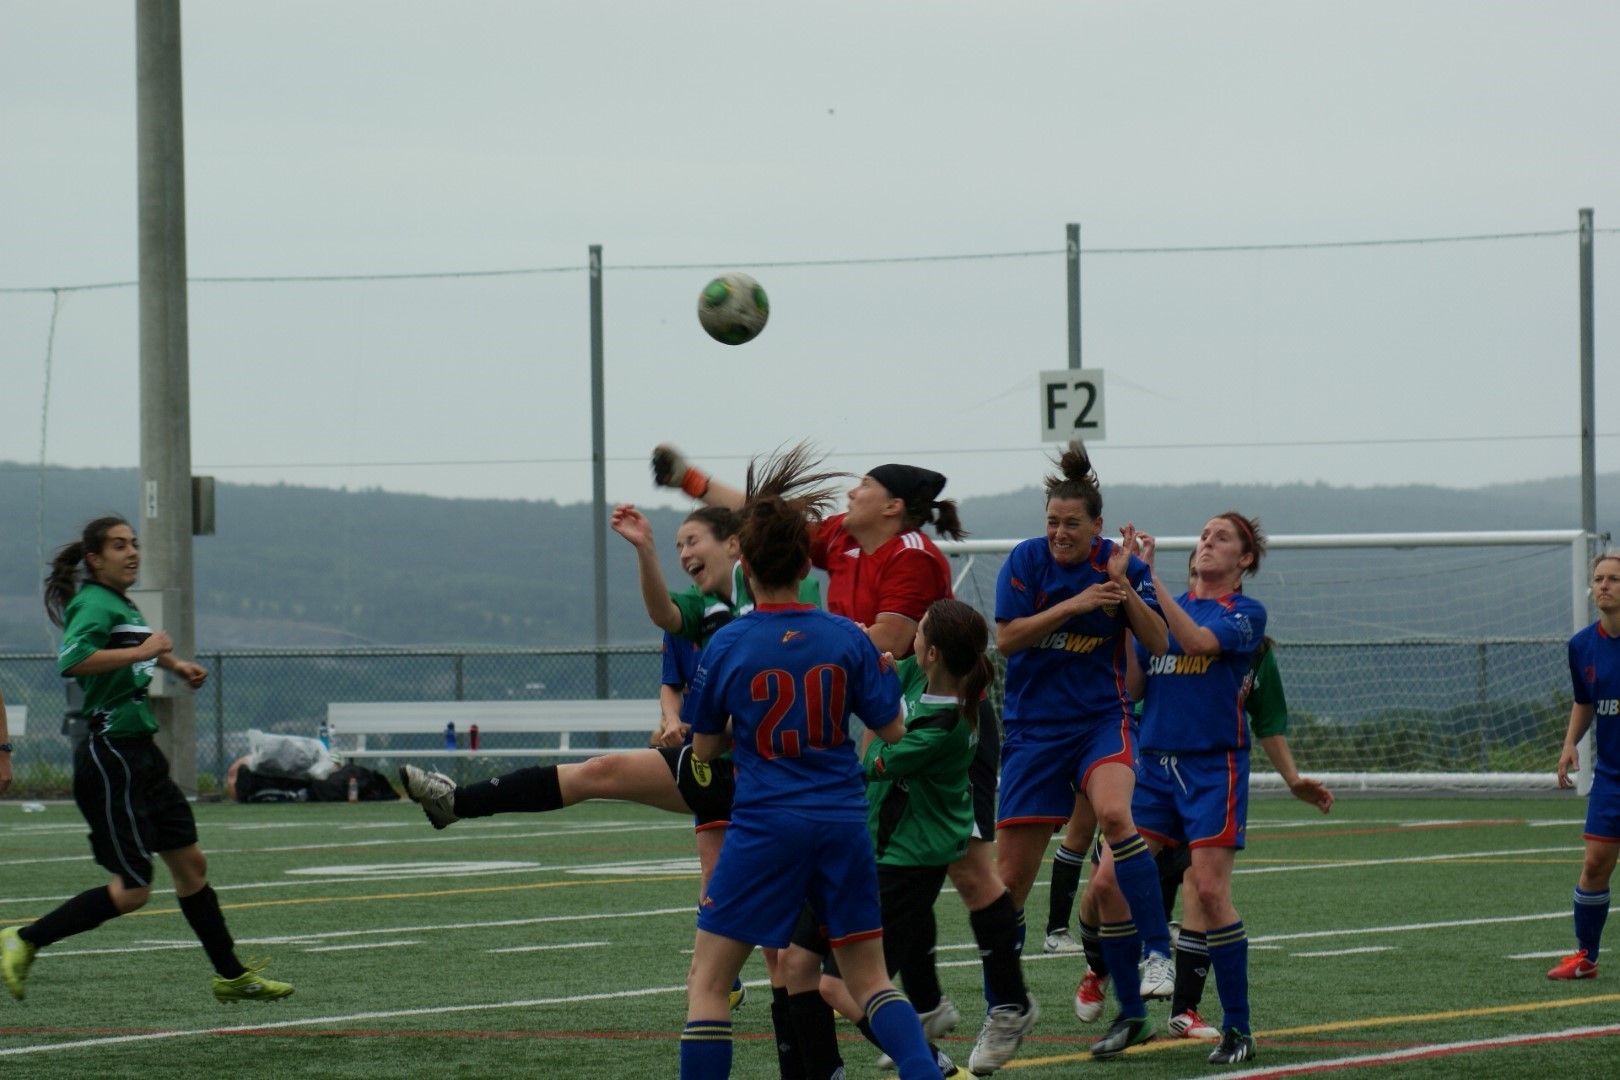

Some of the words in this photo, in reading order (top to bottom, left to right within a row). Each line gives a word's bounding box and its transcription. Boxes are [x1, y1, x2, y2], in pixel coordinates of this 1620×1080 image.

[1046, 381, 1098, 430] F2
[1033, 632, 1105, 654] UBWA
[1146, 654, 1214, 676] SUBWAY
[751, 663, 848, 760] 20
[1597, 699, 1620, 715] UB
